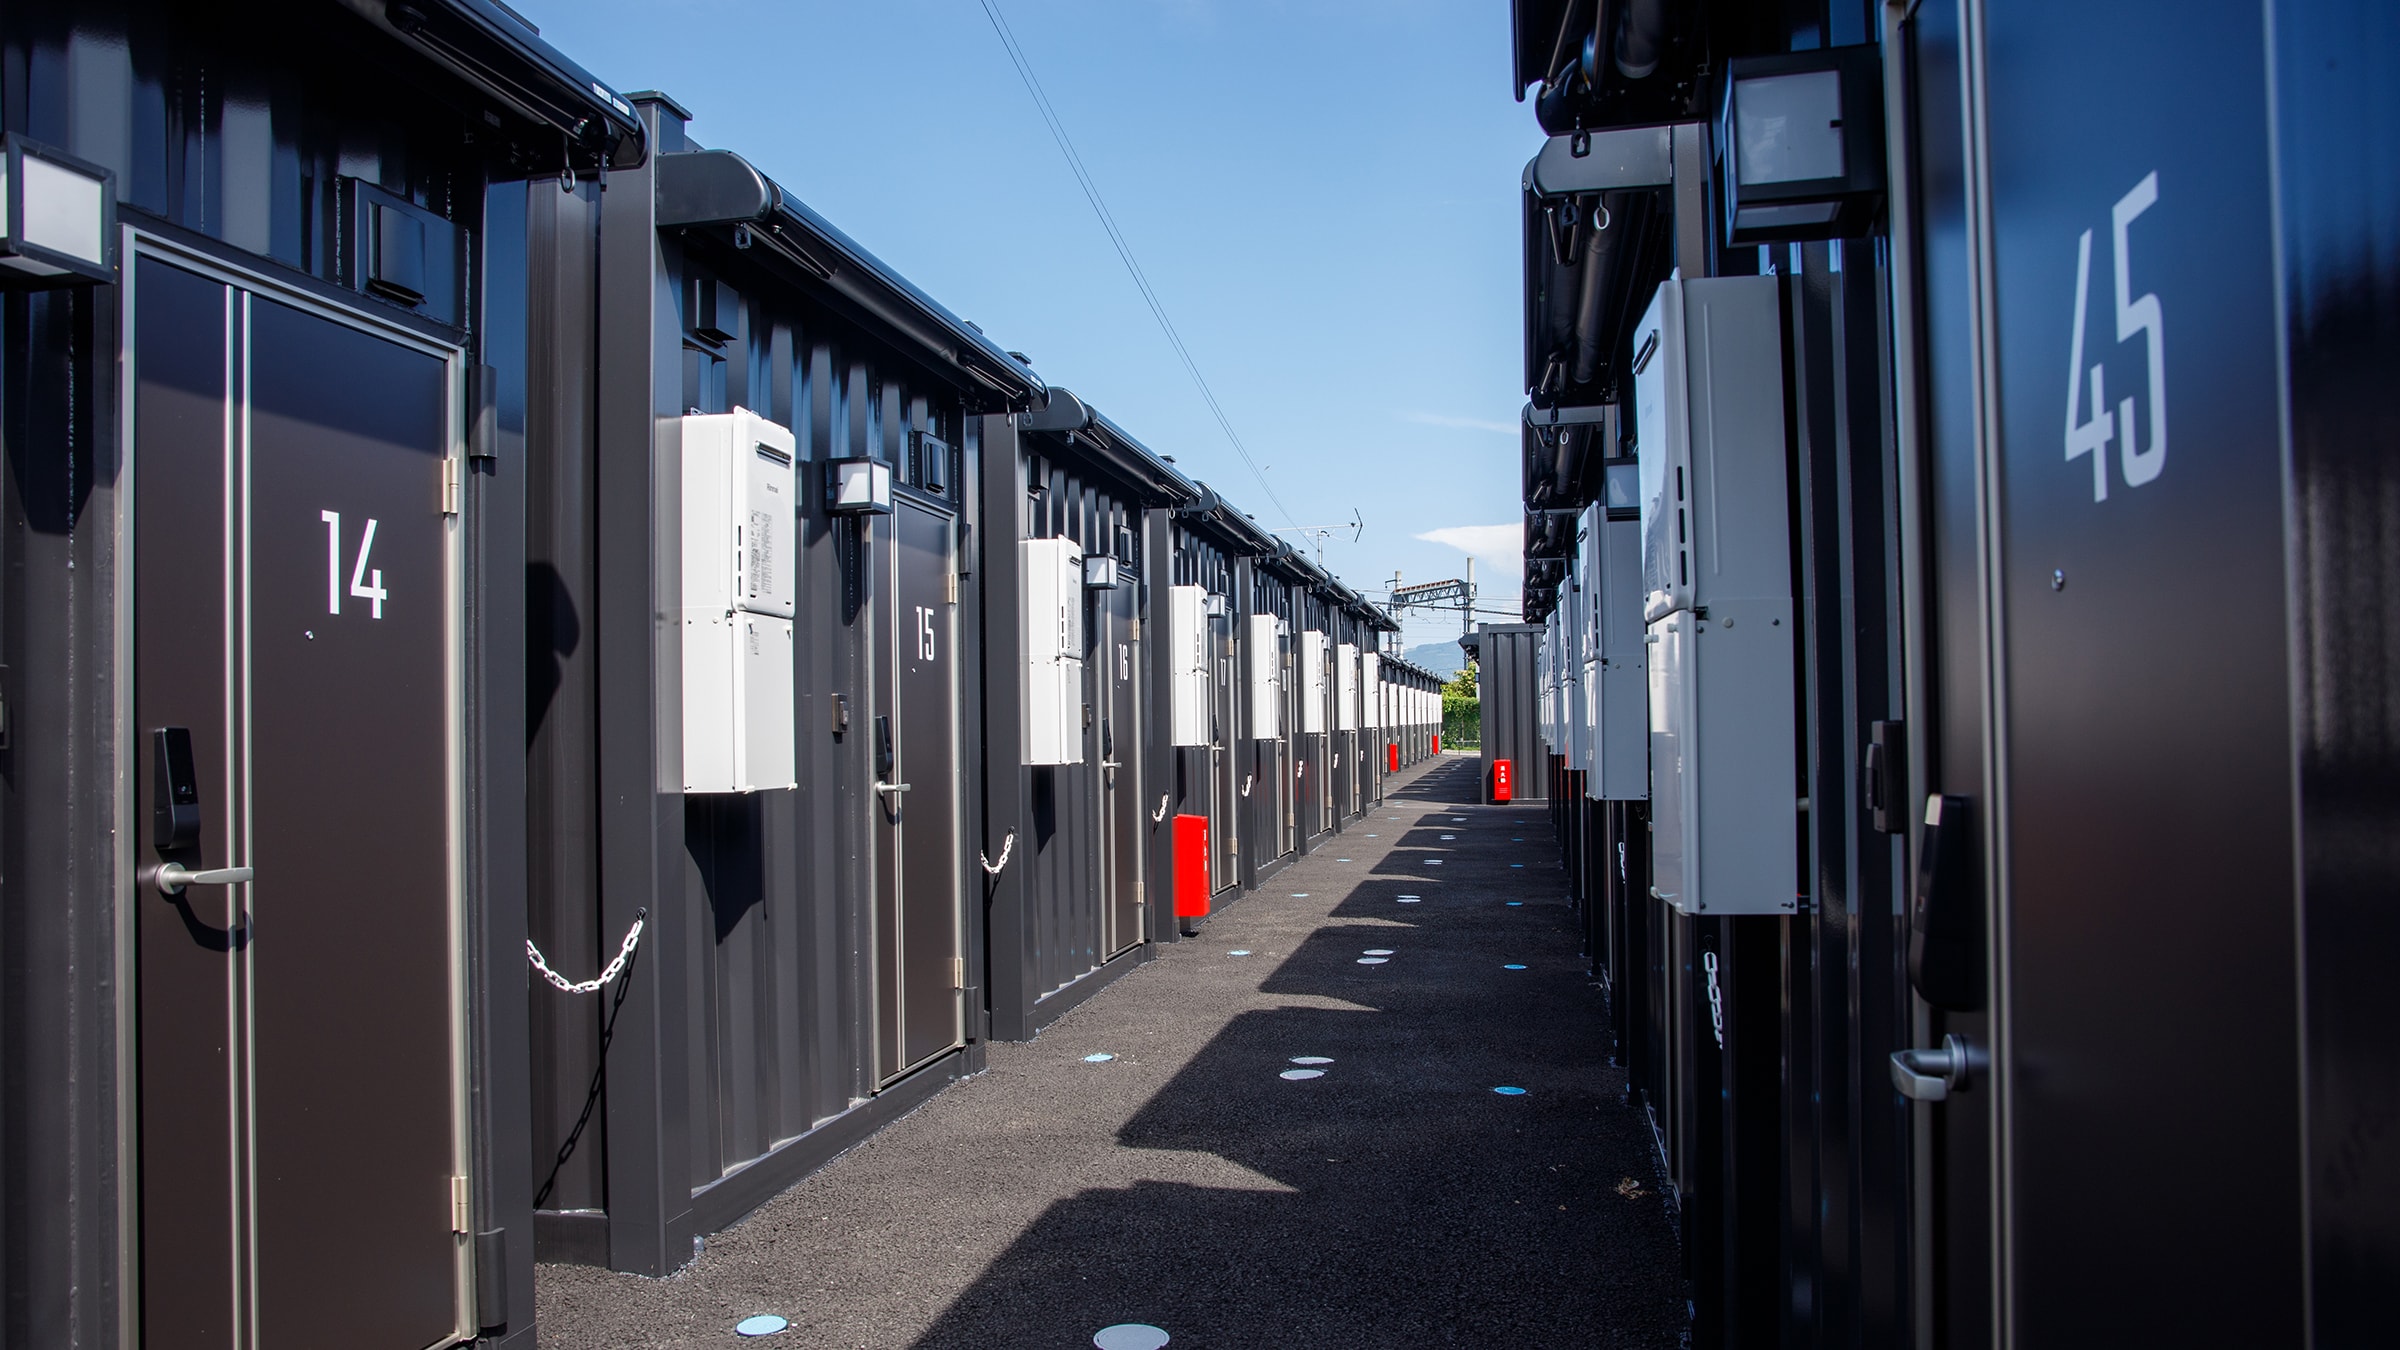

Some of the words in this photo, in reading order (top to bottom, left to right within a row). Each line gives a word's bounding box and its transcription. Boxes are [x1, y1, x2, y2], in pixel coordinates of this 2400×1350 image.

[2065, 170, 2168, 503] 45
[321, 510, 388, 620] 14
[915, 605, 936, 662] 15
[1118, 643, 1129, 681] 16
